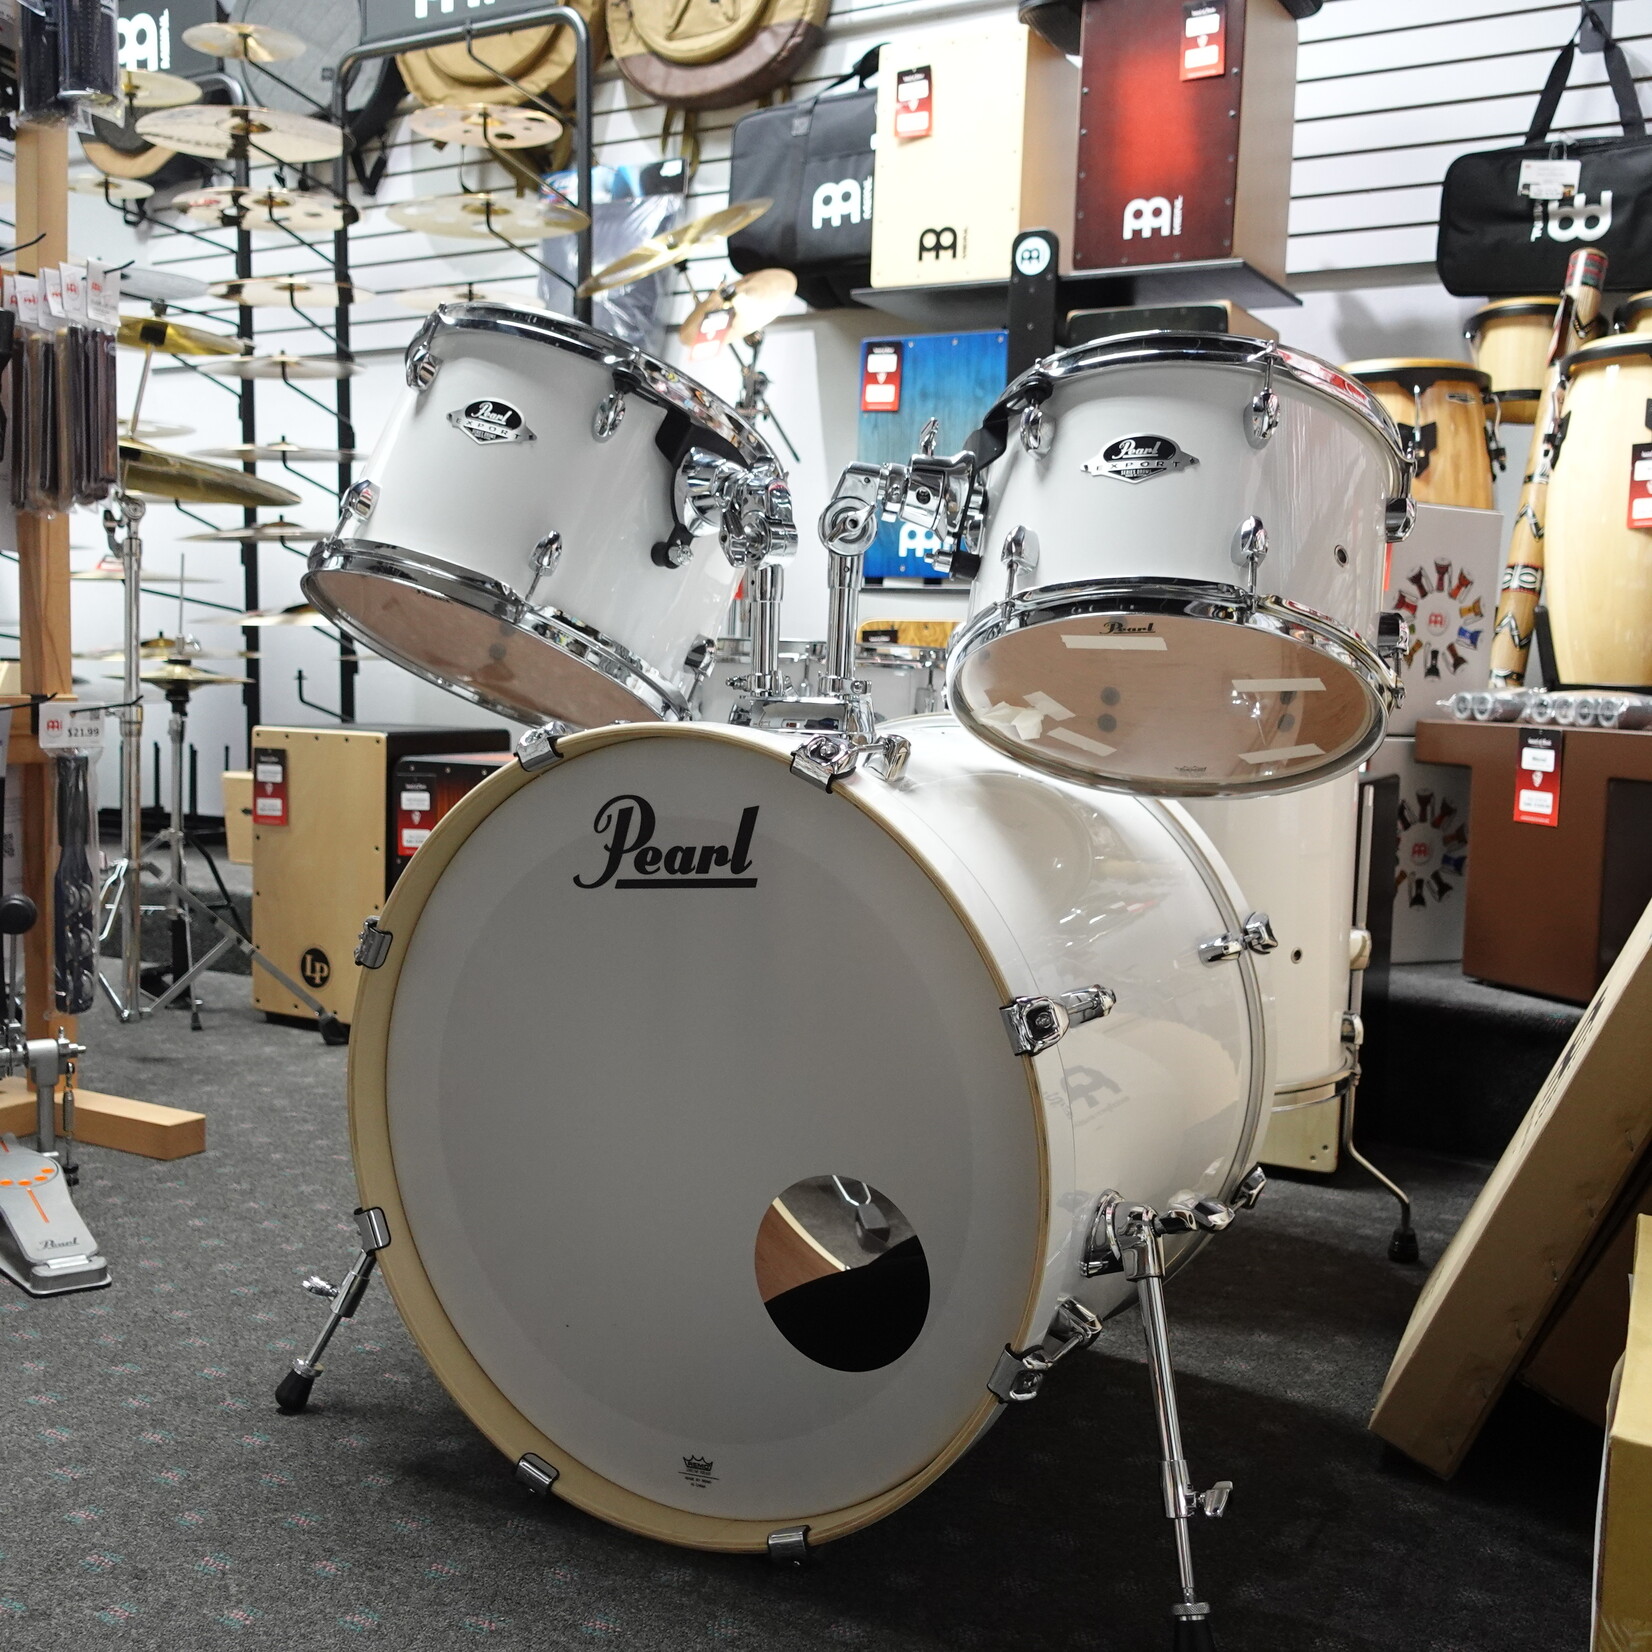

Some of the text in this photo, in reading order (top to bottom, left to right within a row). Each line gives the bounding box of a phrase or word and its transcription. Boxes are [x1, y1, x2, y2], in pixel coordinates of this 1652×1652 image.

[470, 401, 513, 426] Pearl
[456, 418, 521, 440] EXPORT
[1111, 439, 1162, 460] Pearl
[1096, 460, 1181, 471] EXPORT
[1099, 621, 1156, 635] Pearl
[573, 794, 760, 890] Pearl
[37, 1236, 80, 1251] Pearl
